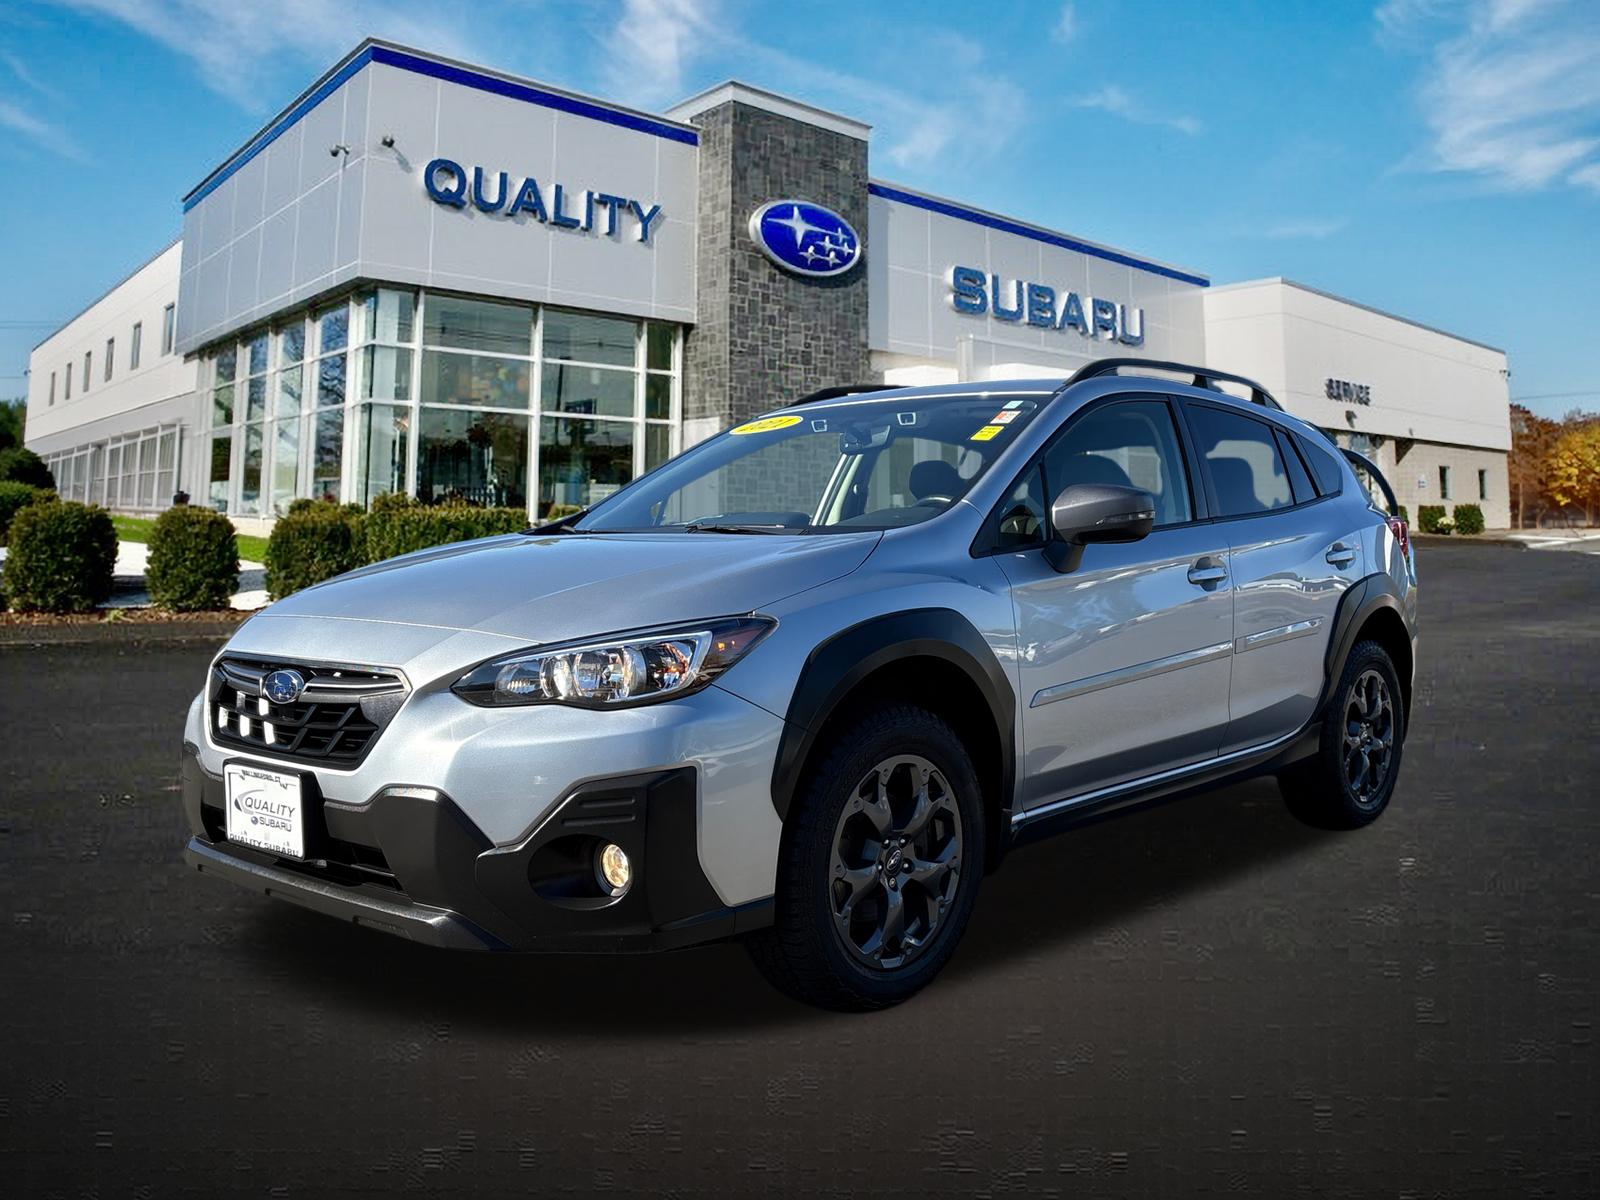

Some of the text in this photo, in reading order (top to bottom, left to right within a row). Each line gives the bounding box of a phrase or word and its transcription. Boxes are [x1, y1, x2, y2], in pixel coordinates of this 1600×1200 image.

[422, 158, 661, 243] QUALITY
[948, 265, 1145, 347] SUBARU
[1325, 378, 1371, 406] SERVICE
[244, 796, 295, 818] QUALITY
[259, 816, 292, 832] SUBARU
[230, 833, 299, 857] QUALITY SUBARU
